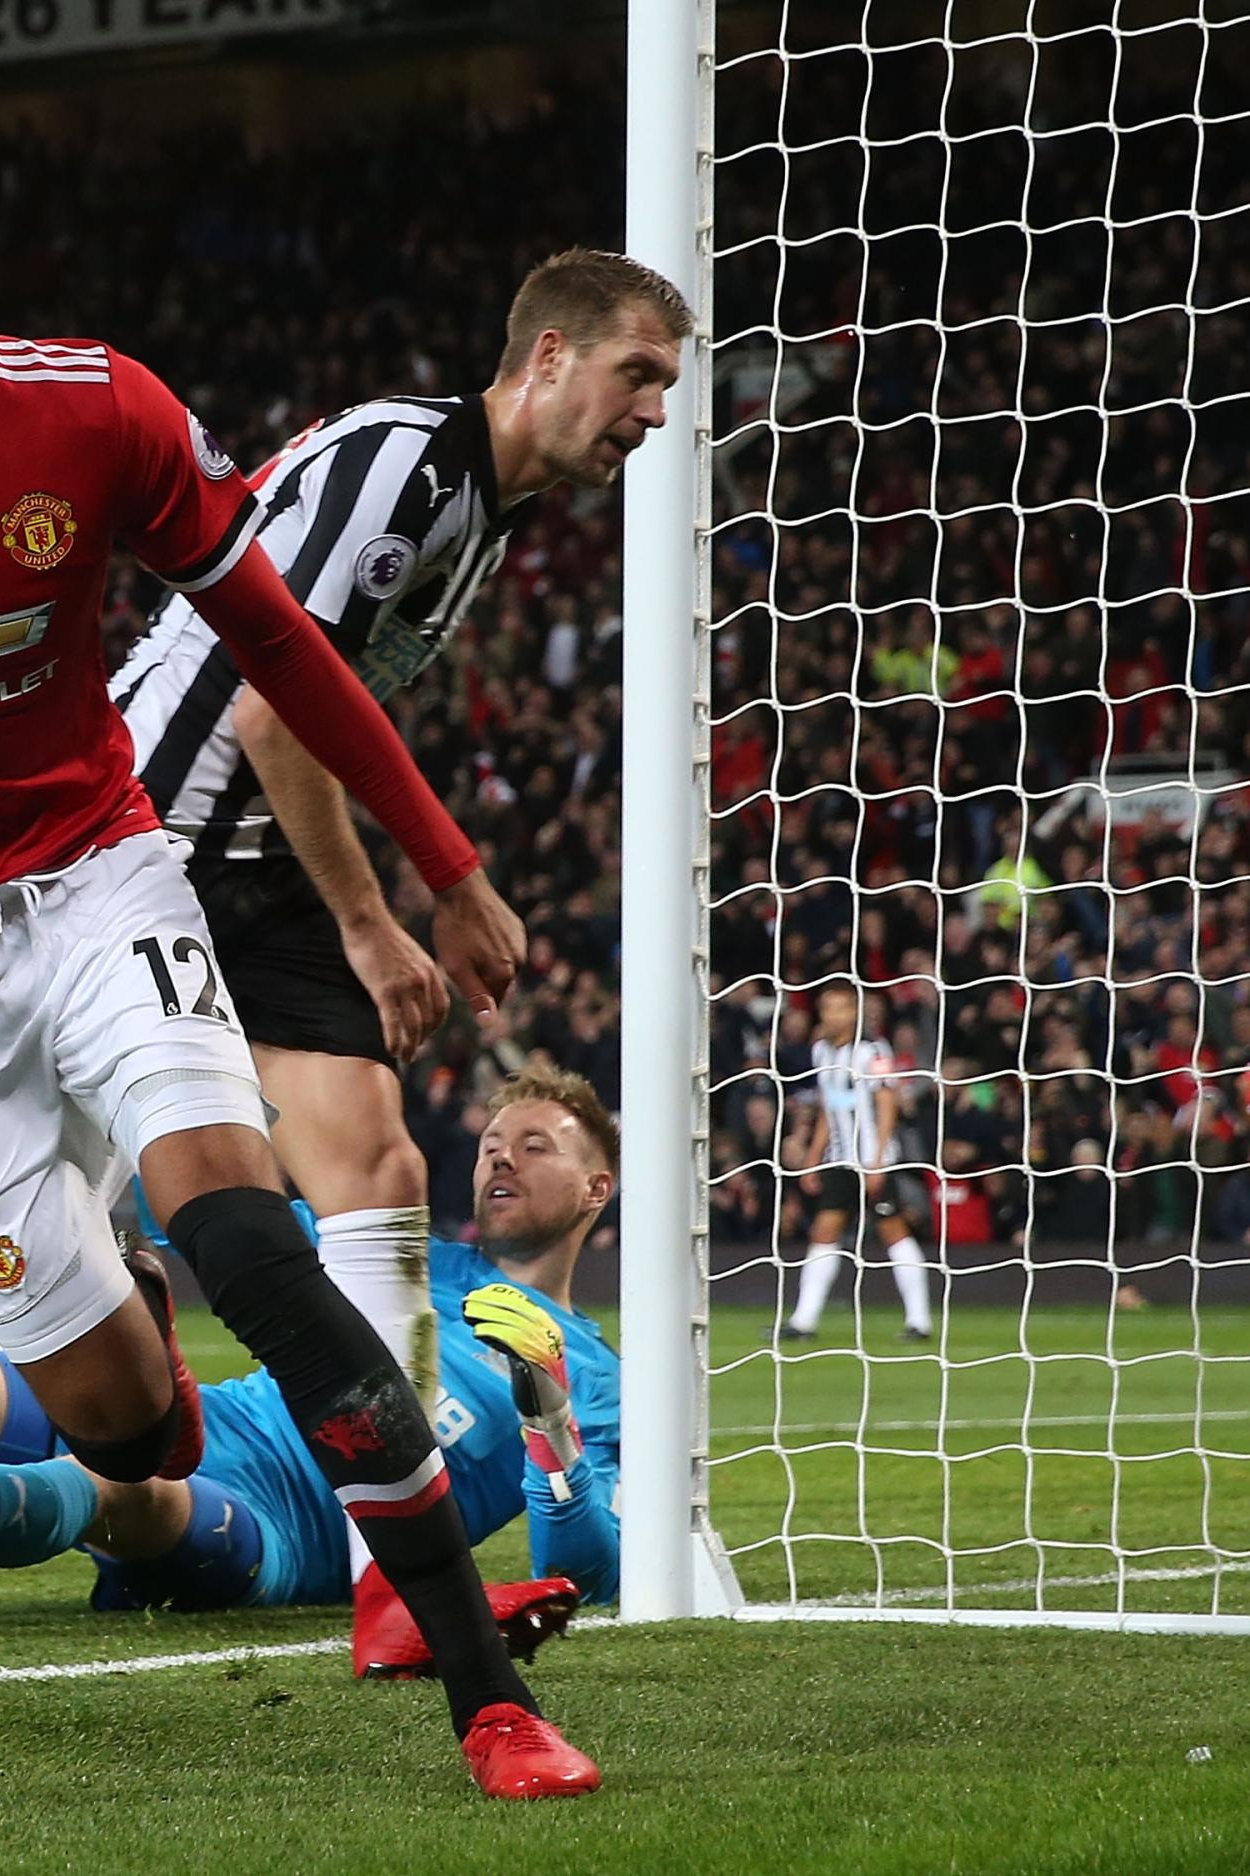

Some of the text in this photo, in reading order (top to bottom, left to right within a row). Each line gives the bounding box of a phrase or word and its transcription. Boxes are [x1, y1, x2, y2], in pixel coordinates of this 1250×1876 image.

[6, 496, 68, 529] MANCHESTER
[23, 546, 66, 565] UNITED
[132, 935, 229, 1022] 12
